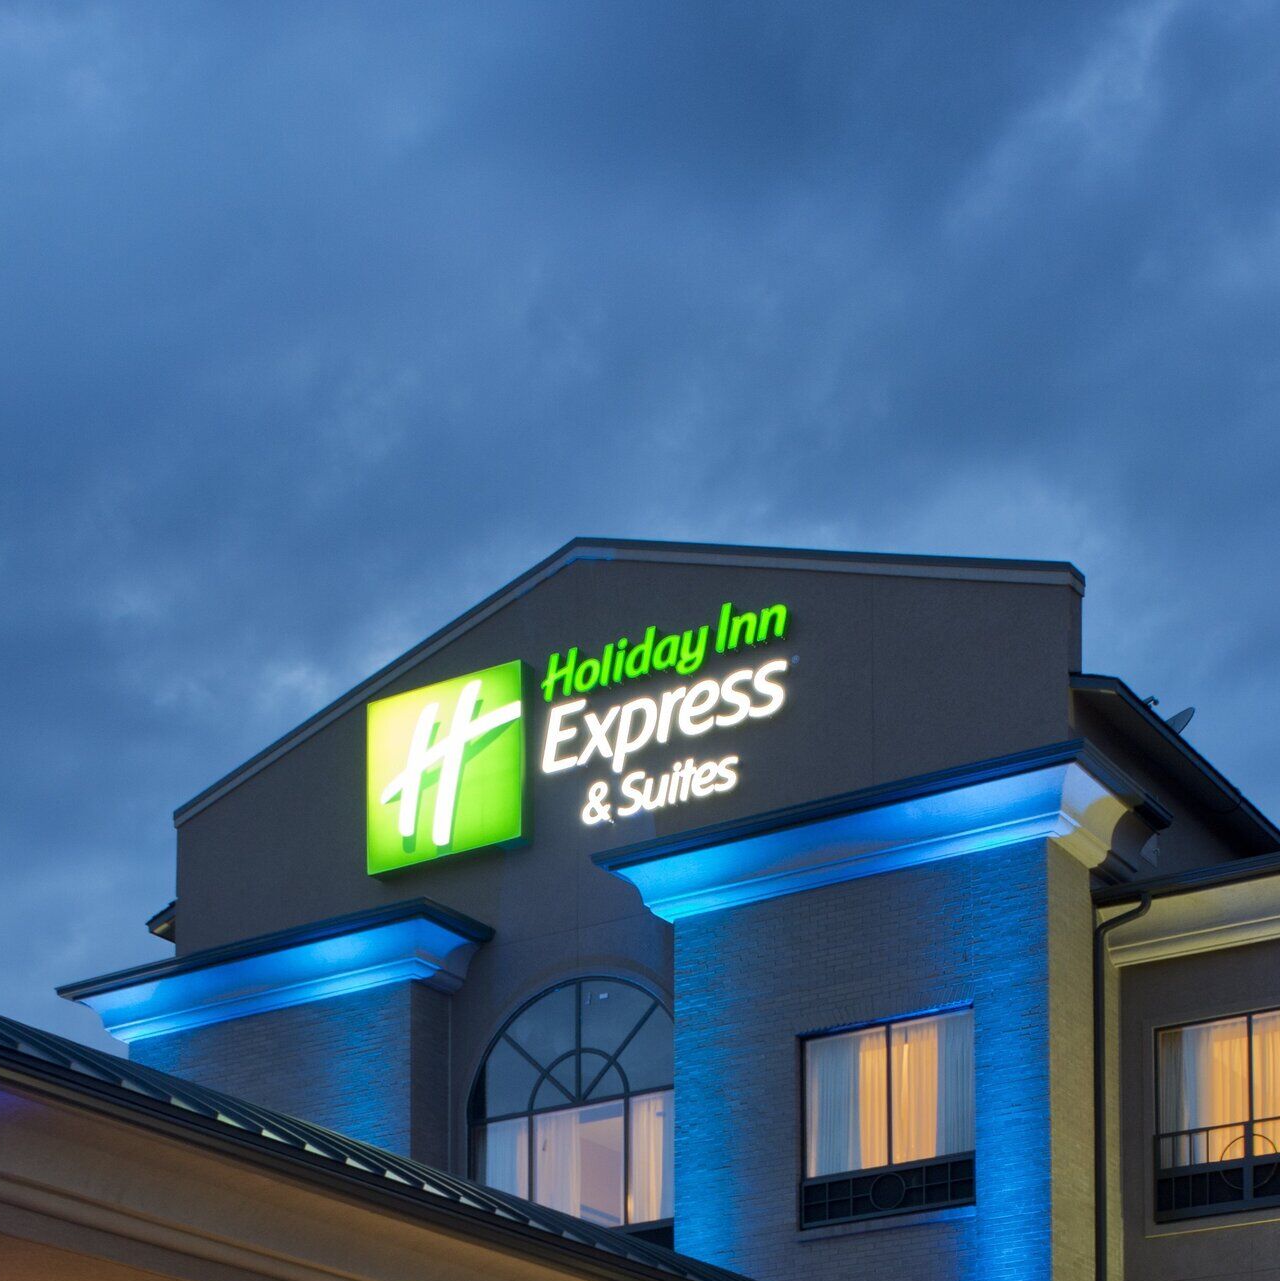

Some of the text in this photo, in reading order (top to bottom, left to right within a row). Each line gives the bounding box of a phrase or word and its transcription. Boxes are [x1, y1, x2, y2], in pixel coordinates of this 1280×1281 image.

[542, 602, 787, 701] Holiday Inn
[542, 660, 787, 773] Express
[581, 756, 739, 825] & Suites
